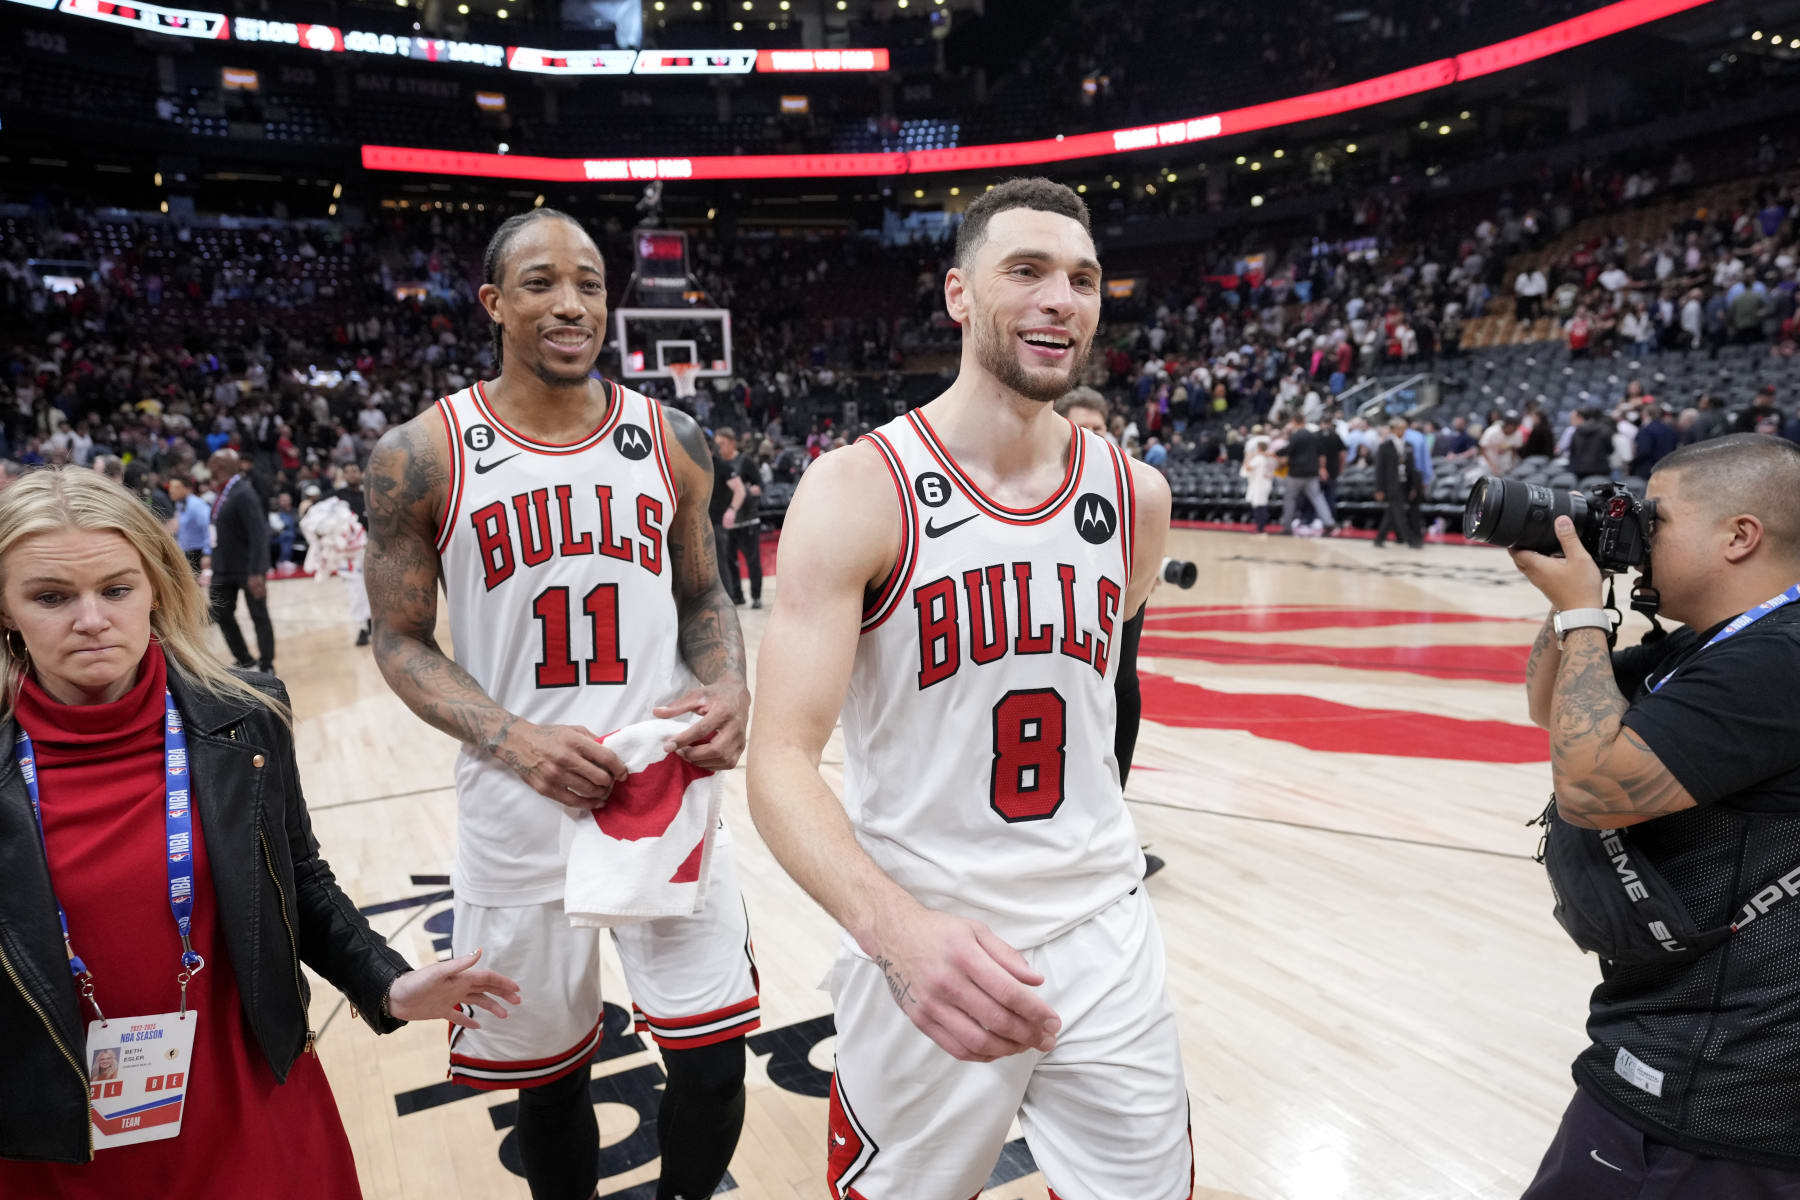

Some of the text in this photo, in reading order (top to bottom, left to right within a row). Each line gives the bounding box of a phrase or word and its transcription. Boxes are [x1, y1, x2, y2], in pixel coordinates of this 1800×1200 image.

[470, 427, 489, 449] 6
[921, 477, 943, 503] 6
[470, 484, 663, 592] BULLS
[533, 583, 629, 689] 11
[913, 561, 1121, 691] BULLS
[167, 708, 183, 728] NBA
[167, 748, 187, 767] NBA
[990, 687, 1067, 823] 8
[169, 789, 188, 810] NBA
[169, 831, 190, 854] NBA
[170, 875, 191, 898] NBA
[120, 1029, 164, 1043] NBA SEASON
[121, 1116, 141, 1129] TEAM
